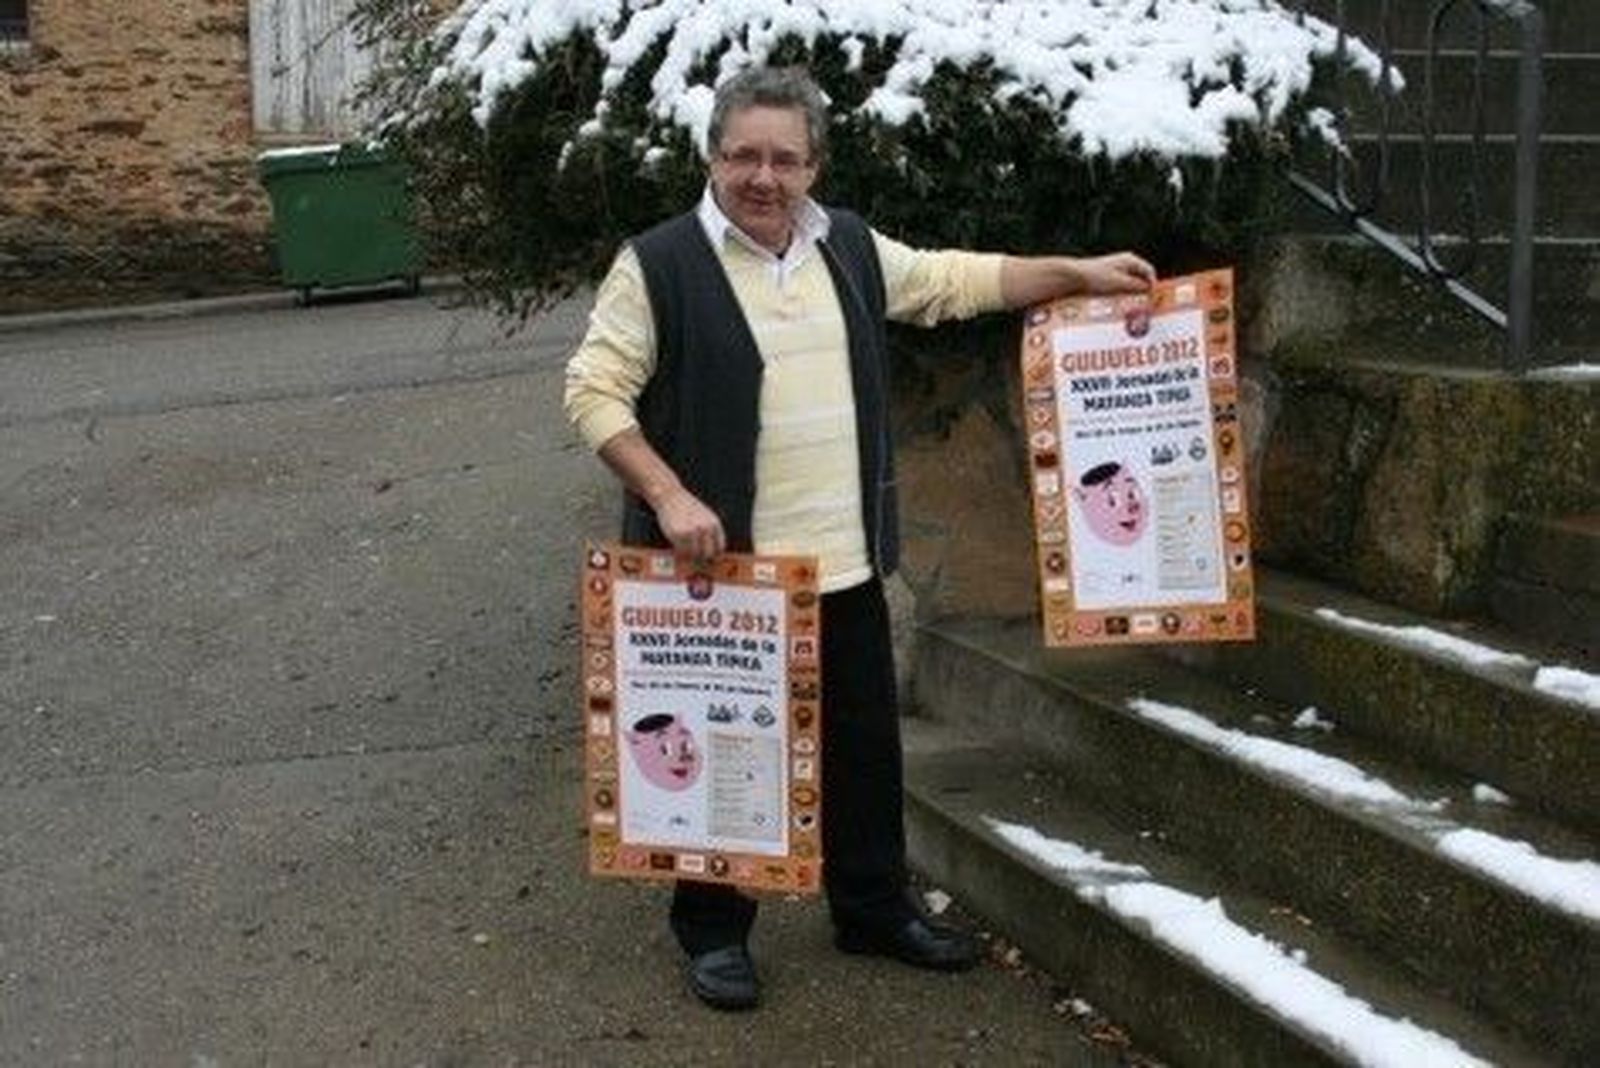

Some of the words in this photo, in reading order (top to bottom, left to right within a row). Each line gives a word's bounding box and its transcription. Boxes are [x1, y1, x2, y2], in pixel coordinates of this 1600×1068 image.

[1062, 346, 1159, 373] GUIJUELO
[1162, 337, 1198, 364] 2012
[1083, 393, 1152, 412] MATANZA
[622, 608, 722, 629] GUIJUELO
[730, 611, 778, 634] 2012
[641, 651, 712, 666] MATANZA
